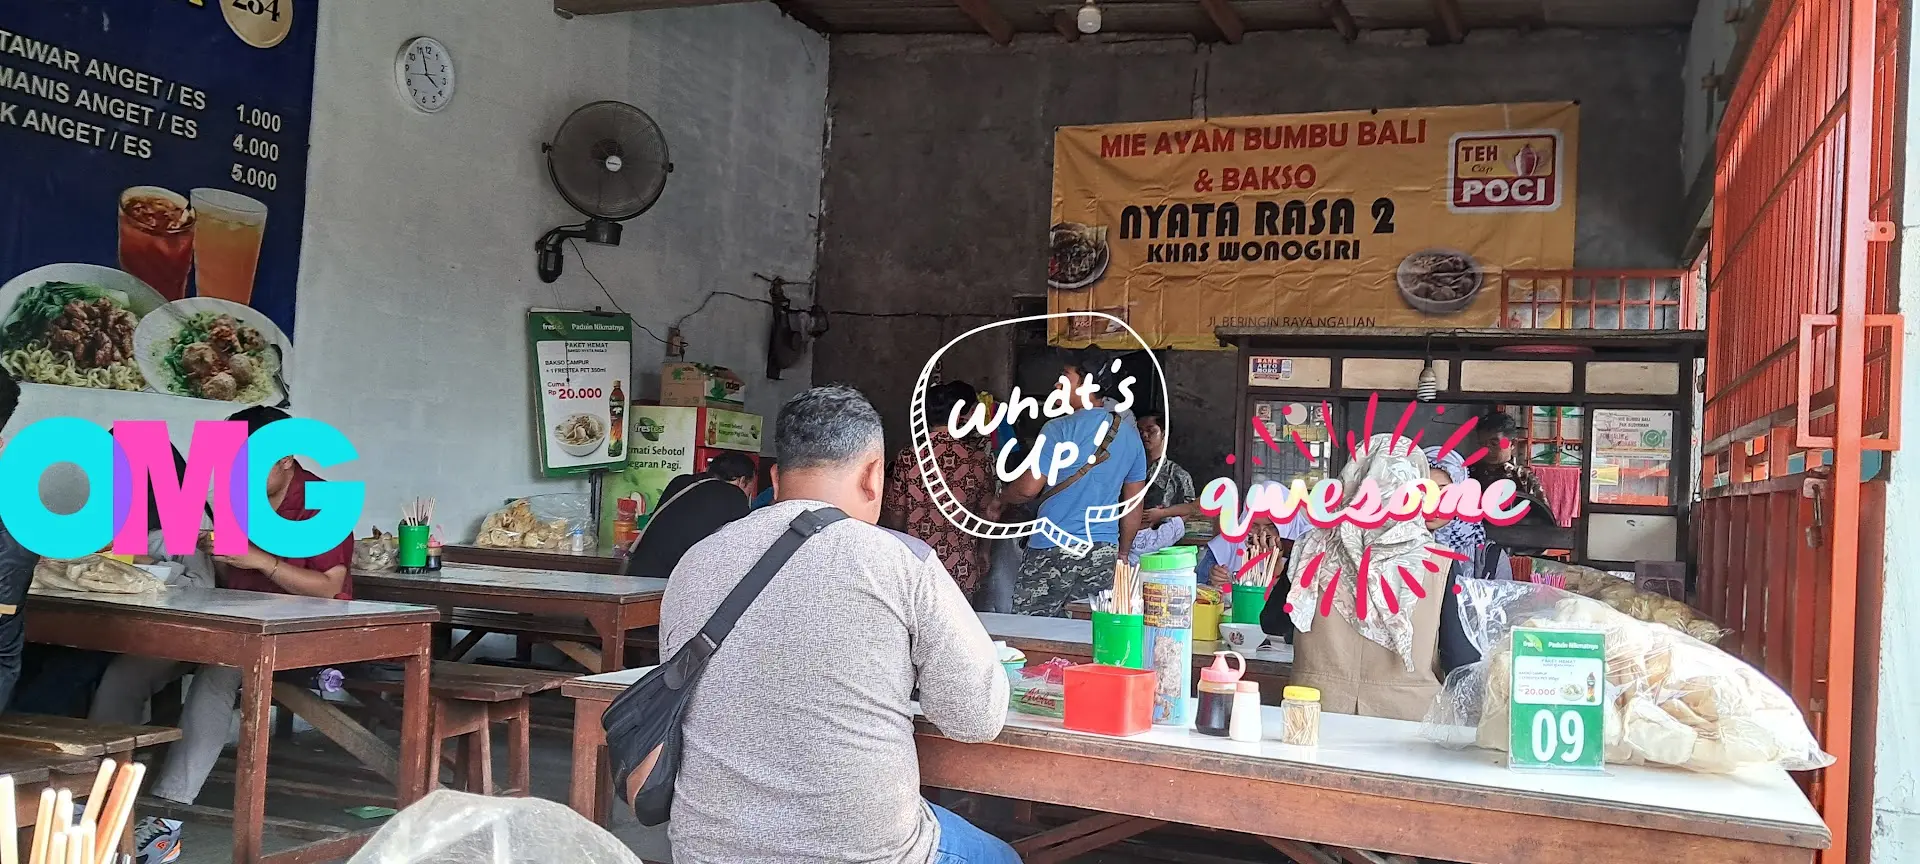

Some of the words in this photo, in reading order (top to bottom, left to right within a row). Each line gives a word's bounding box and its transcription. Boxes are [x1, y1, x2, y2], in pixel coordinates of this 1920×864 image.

[409, 53, 416, 62] 10
[425, 46, 432, 55] 12
[0, 29, 80, 73] TAWAR
[84, 58, 163, 97] ANGET
[167, 82, 175, 101] /
[180, 85, 206, 110] ES
[405, 64, 410, 72] 9
[441, 64, 446, 73] 2
[406, 78, 412, 87] 8
[413, 88, 418, 97] 7
[421, 96, 427, 104] 6
[431, 95, 437, 104] 5
[0, 65, 70, 104] MANIS
[74, 88, 154, 126] ANGET
[158, 111, 166, 130] /
[170, 115, 198, 139] ES
[236, 103, 281, 133] 1.000
[22, 109, 105, 150] ANGET
[109, 131, 118, 151] /
[123, 134, 152, 159] ES
[1100, 132, 1147, 159] MIE
[1153, 129, 1235, 156] AYAM
[1243, 122, 1349, 152] BUMBU
[1356, 119, 1427, 147] BALI
[232, 133, 279, 162] 4.000
[1461, 144, 1499, 162] TEH
[1471, 163, 1494, 175] Cap
[231, 163, 277, 191] 5.000
[1194, 168, 1213, 193] &
[1221, 163, 1317, 191] BAKSO
[1462, 178, 1547, 203] POCI
[1120, 201, 1240, 240] NYATA
[1254, 197, 1356, 236] RASA
[1371, 196, 1396, 235] 2
[1147, 241, 1211, 263] KHAS
[1218, 239, 1361, 262] WONOGIRI
[571, 322, 594, 330] Paduin
[594, 323, 625, 333] Nikmatnya
[1222, 316, 1279, 328] BERINGIN
[1282, 316, 1313, 328] RAYA
[558, 388, 602, 400] 20.000
[652, 445, 685, 456] Sebotol
[1531, 708, 1585, 763] 09
